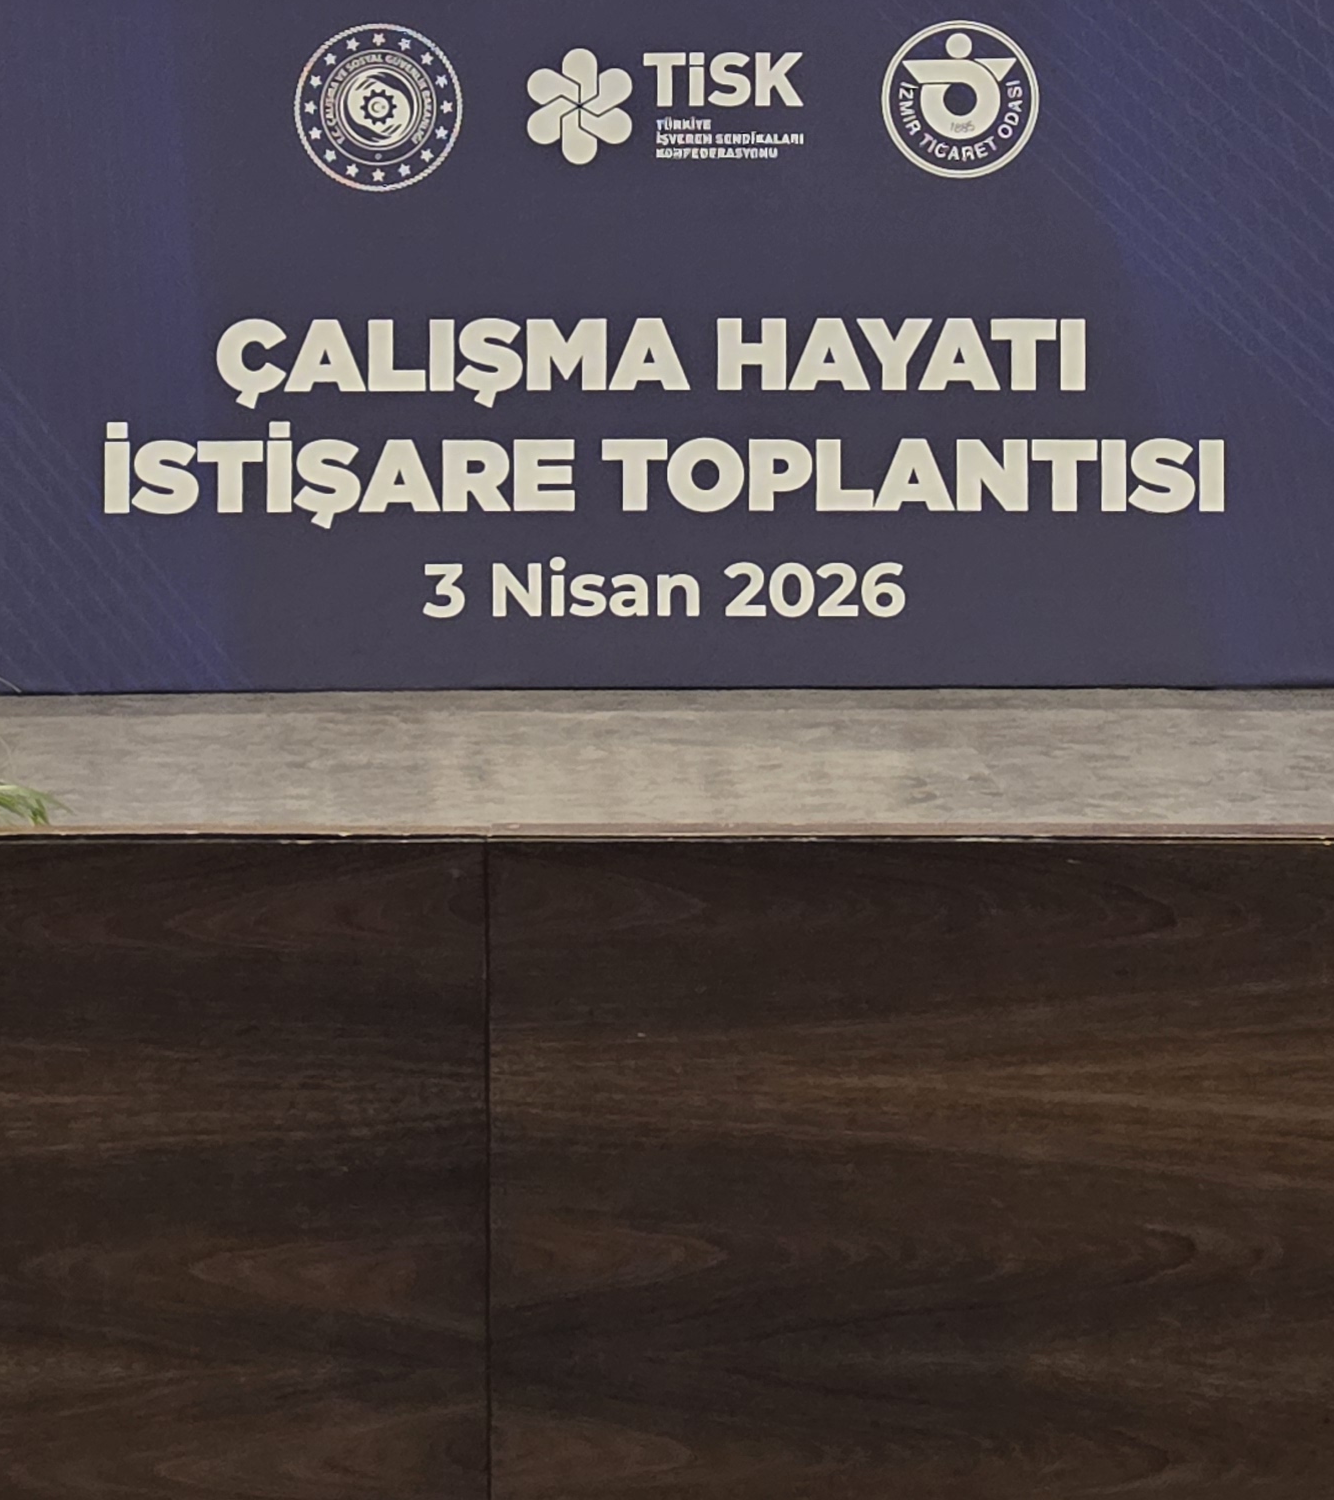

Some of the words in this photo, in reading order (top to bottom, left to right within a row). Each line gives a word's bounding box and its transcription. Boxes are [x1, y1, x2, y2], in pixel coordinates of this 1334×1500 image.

[656, 116, 712, 131] TÜRKİYE
[996, 79, 1024, 139] ODASI
[216, 317, 691, 410] ÇALIŞMA
[716, 317, 1086, 391] HAYATI
[103, 420, 576, 530] İSTİŞARE
[601, 437, 1225, 514] TOPLANTISI
[422, 563, 466, 619] 3
[492, 556, 700, 618] Nisan
[723, 561, 906, 618] 2026
